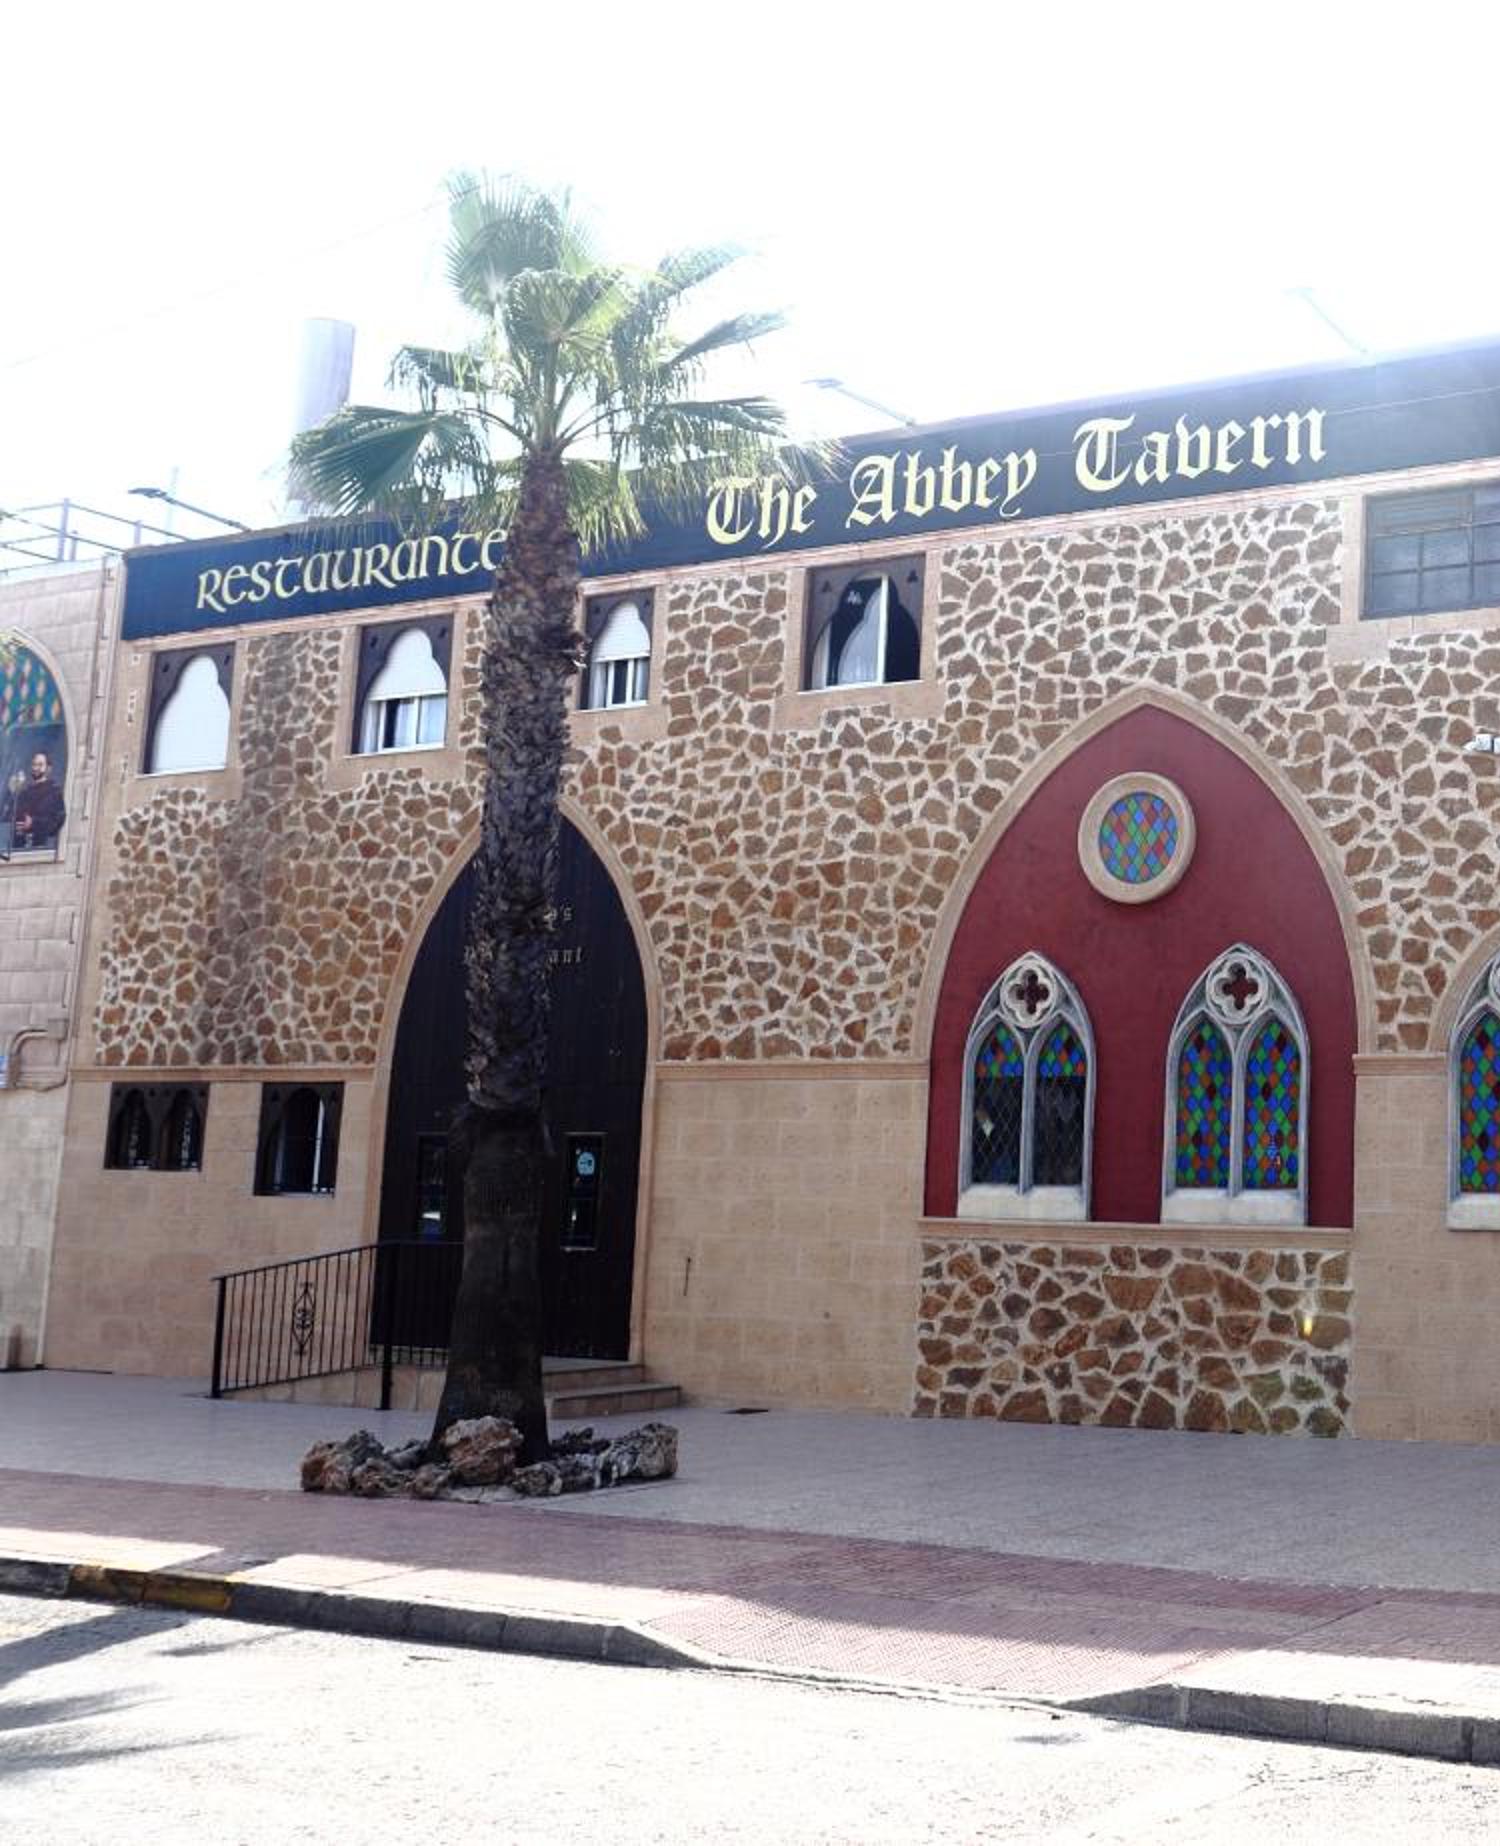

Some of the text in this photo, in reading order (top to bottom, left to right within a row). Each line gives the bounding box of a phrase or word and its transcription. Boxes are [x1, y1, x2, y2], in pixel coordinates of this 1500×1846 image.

[706, 407, 1327, 549] The Abbey Tavern
